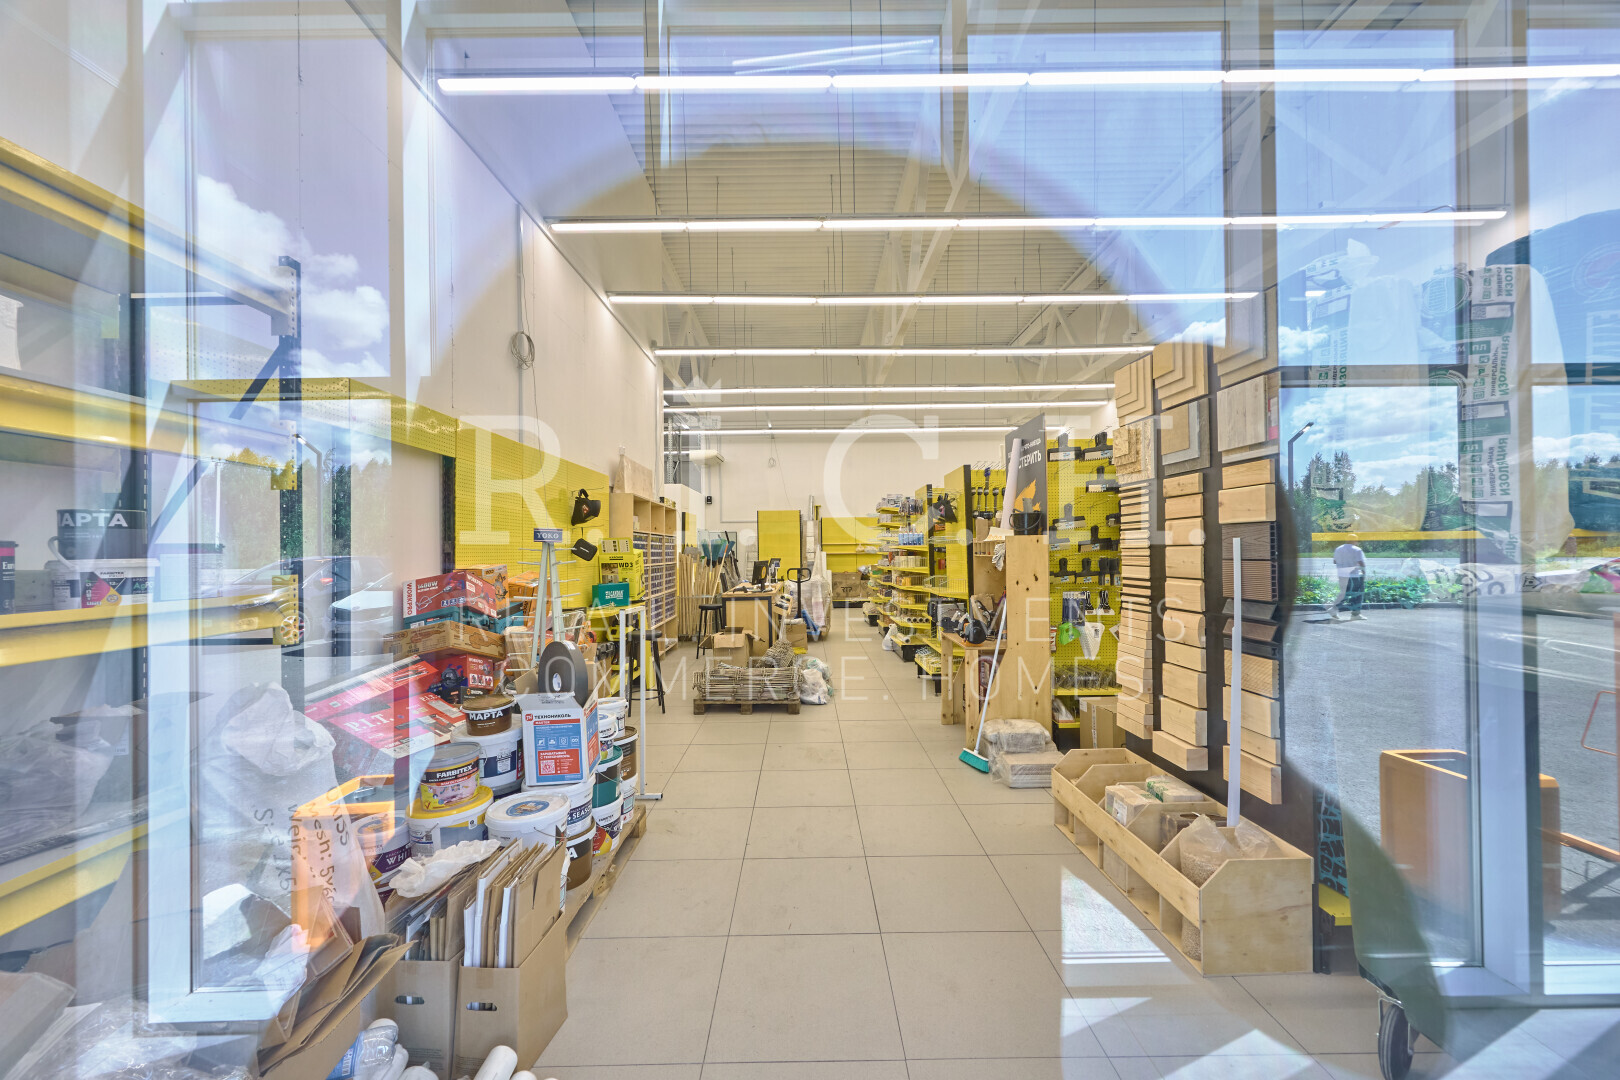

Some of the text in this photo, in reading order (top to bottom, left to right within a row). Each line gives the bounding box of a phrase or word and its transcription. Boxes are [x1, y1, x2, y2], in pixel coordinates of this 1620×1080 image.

[1498, 335, 1511, 396] ИЗОЛЯЦИЯ
[1497, 437, 1511, 496] ИЗОЛЯЦИЯ
[469, 710, 504, 721] МАРТА
[436, 763, 473, 779] FARBITEX
